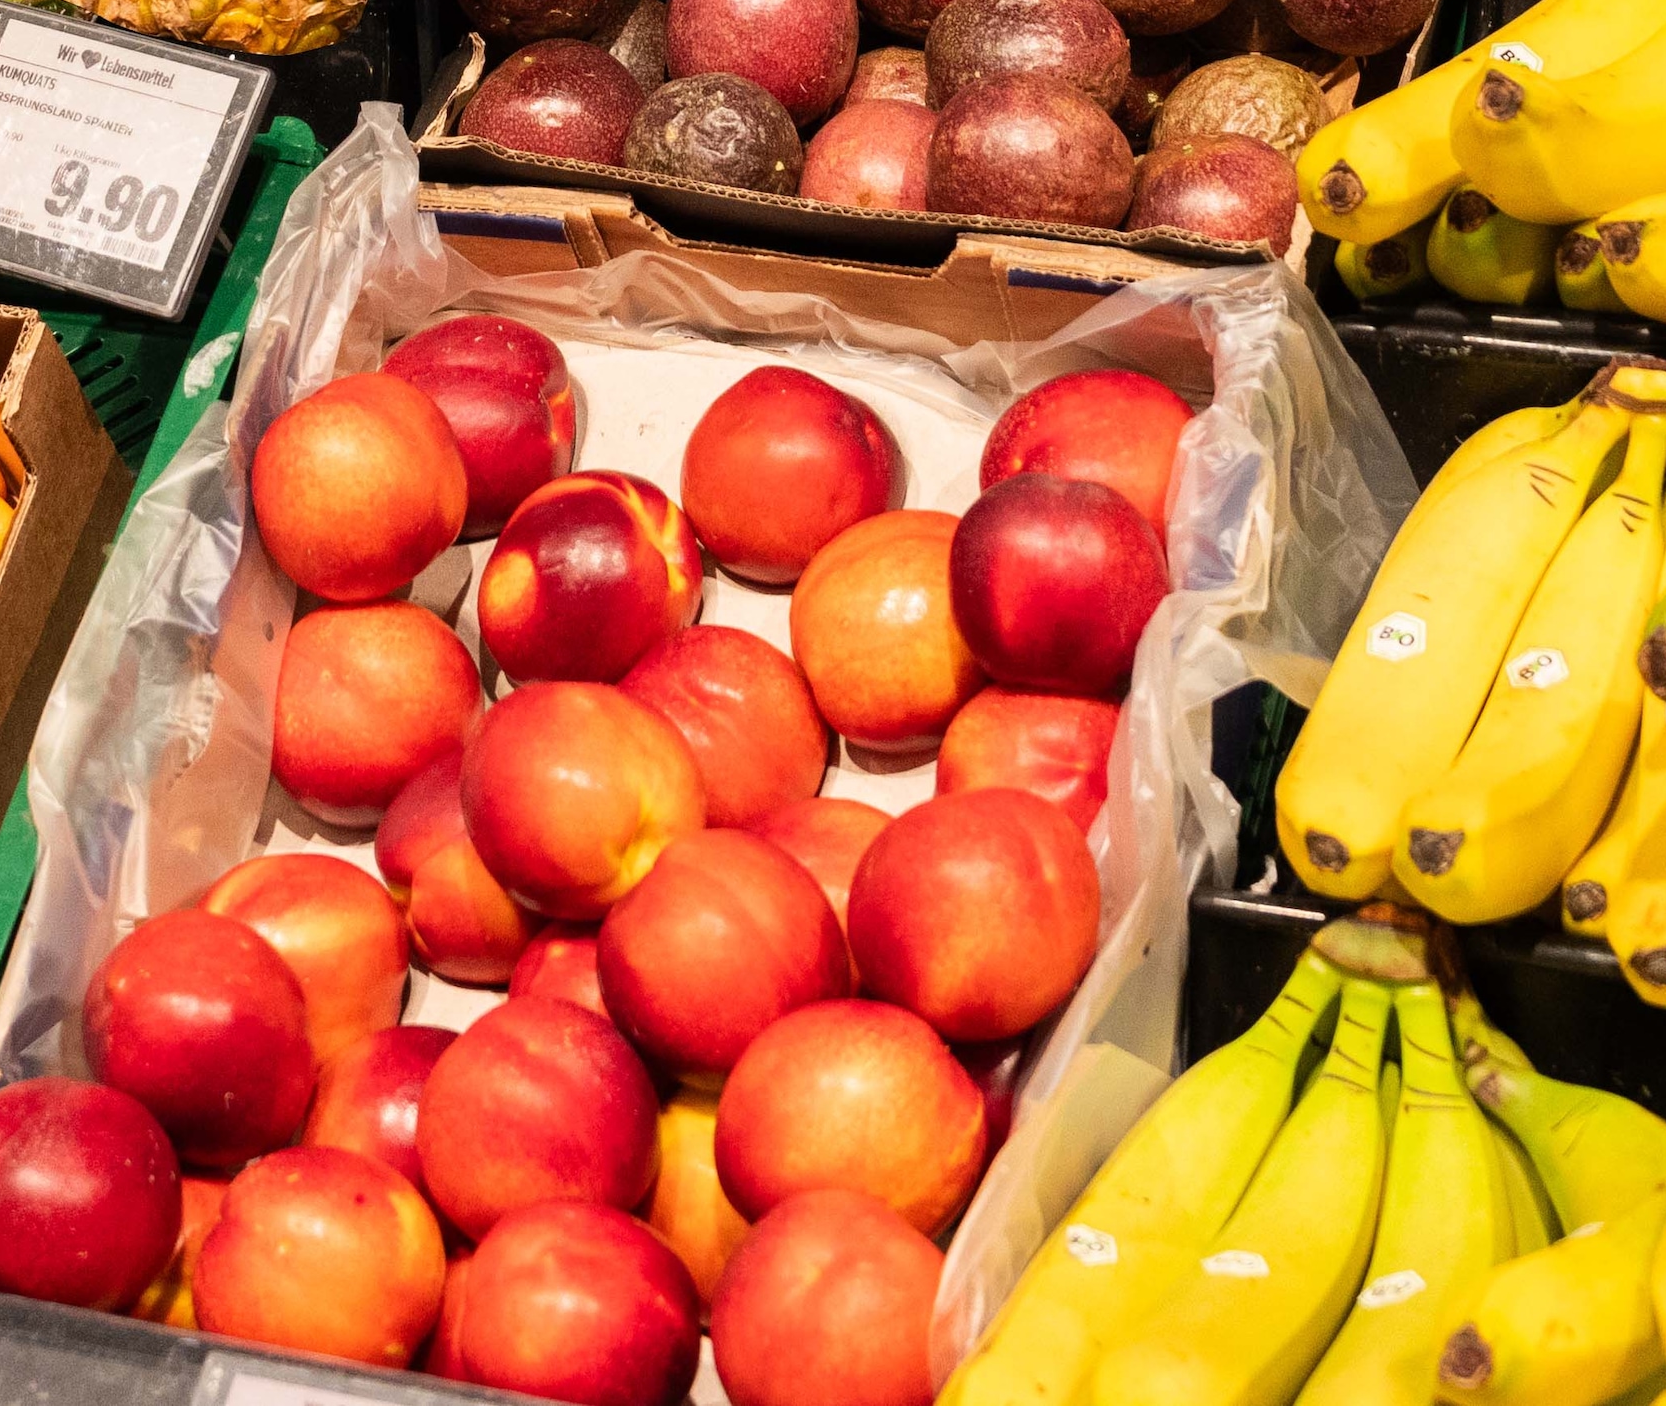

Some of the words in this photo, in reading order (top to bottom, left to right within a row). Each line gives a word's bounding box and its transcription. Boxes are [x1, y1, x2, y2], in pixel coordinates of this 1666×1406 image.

[58, 44, 79, 64] Wir
[84, 115, 133, 136] SPANIEN
[44, 158, 179, 243] 9.90
